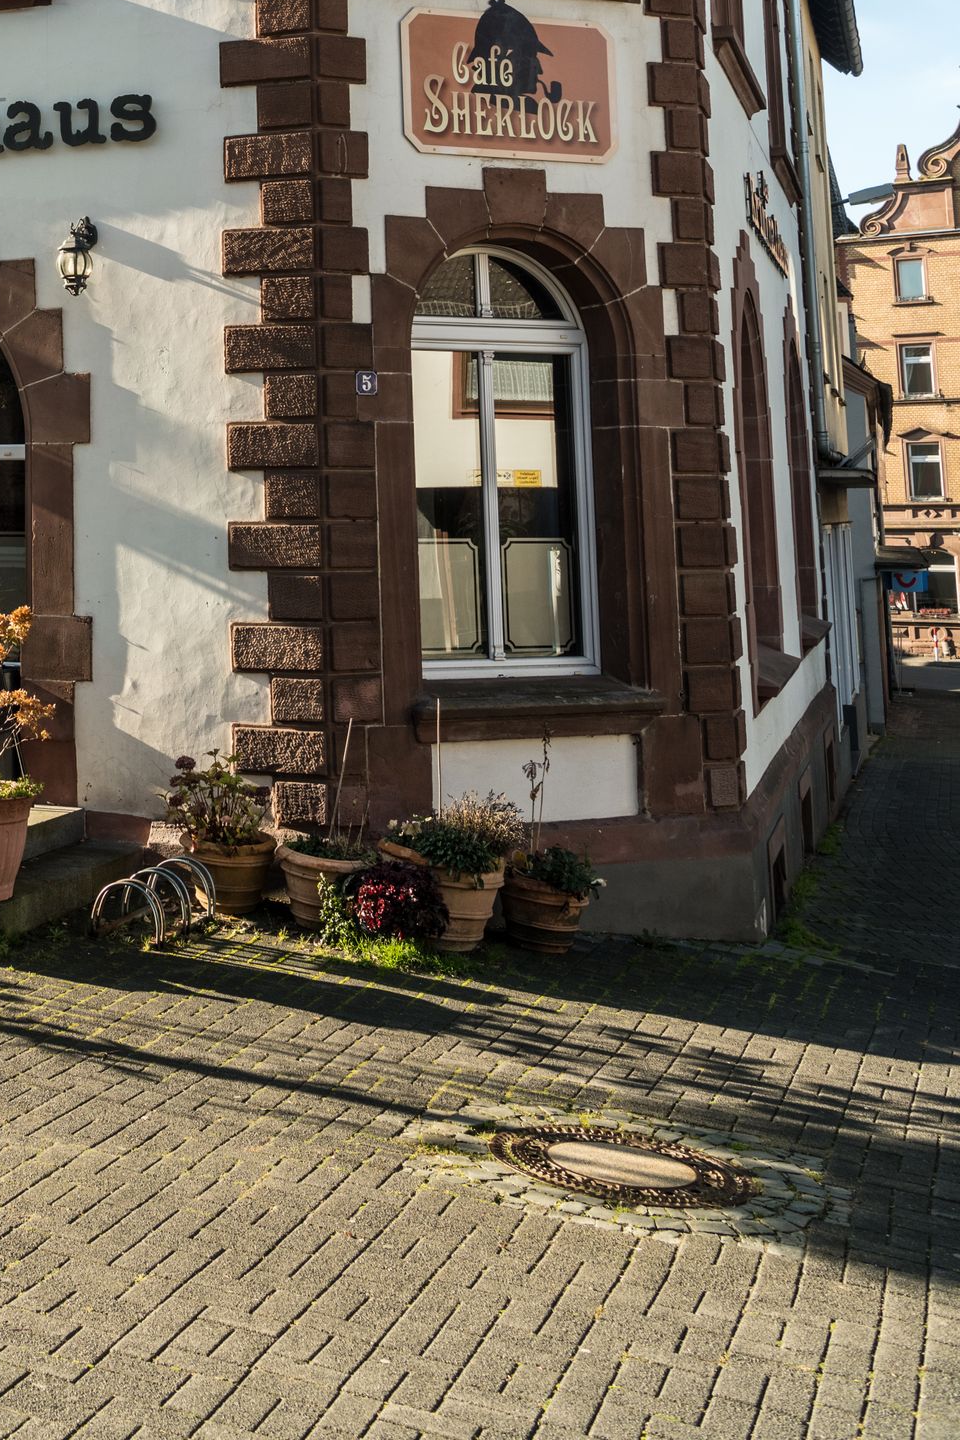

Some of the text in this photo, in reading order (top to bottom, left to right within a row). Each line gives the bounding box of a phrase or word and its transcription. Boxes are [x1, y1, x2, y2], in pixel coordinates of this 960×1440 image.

[452, 41, 514, 87] Café
[423, 73, 599, 143] SHERLOCK
[362, 375, 372, 391] 5
